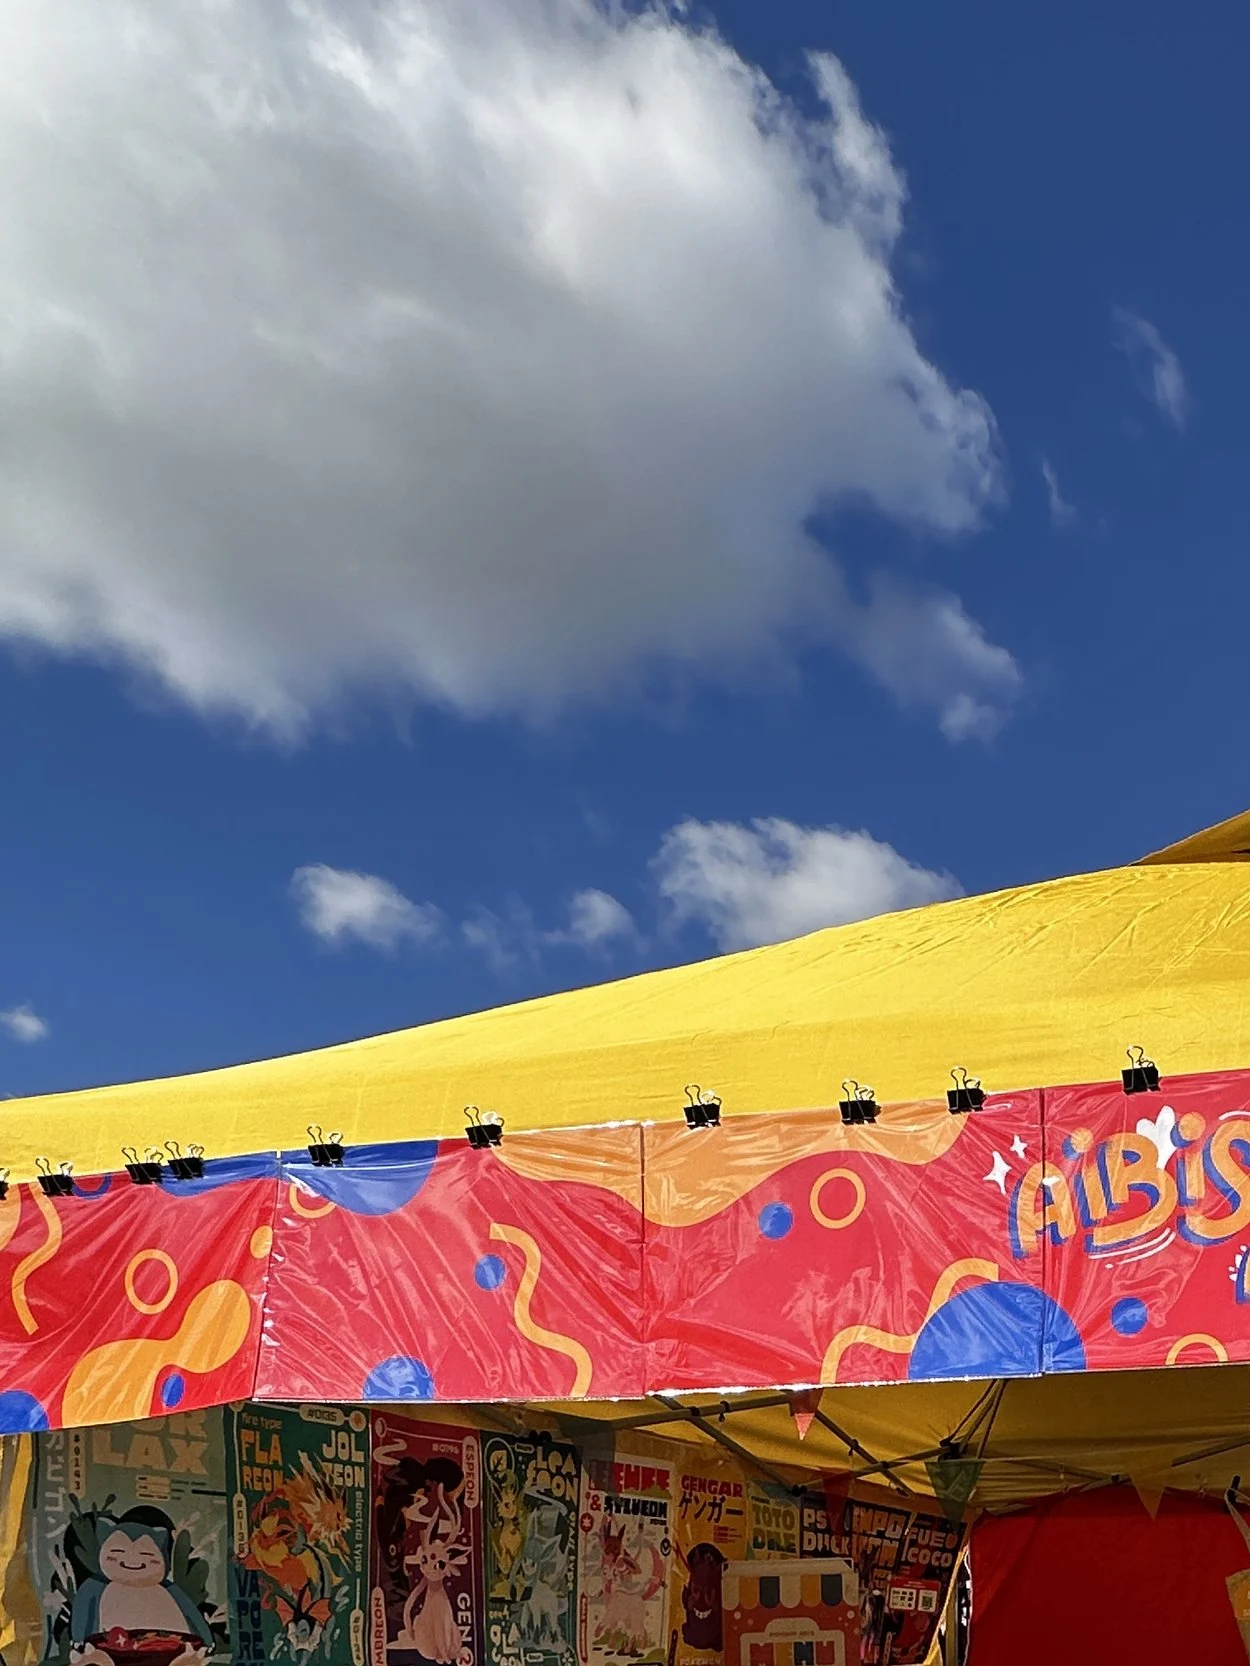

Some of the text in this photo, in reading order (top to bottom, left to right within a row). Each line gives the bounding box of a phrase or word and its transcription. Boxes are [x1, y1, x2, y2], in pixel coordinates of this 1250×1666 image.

[240, 1429, 283, 1465] FLA
[322, 1429, 365, 1462] JOL
[466, 1445, 475, 1500] ESPEON
[681, 1475, 743, 1498] GENGAR
[590, 1495, 601, 1511] &
[457, 1592, 472, 1642] GEN
